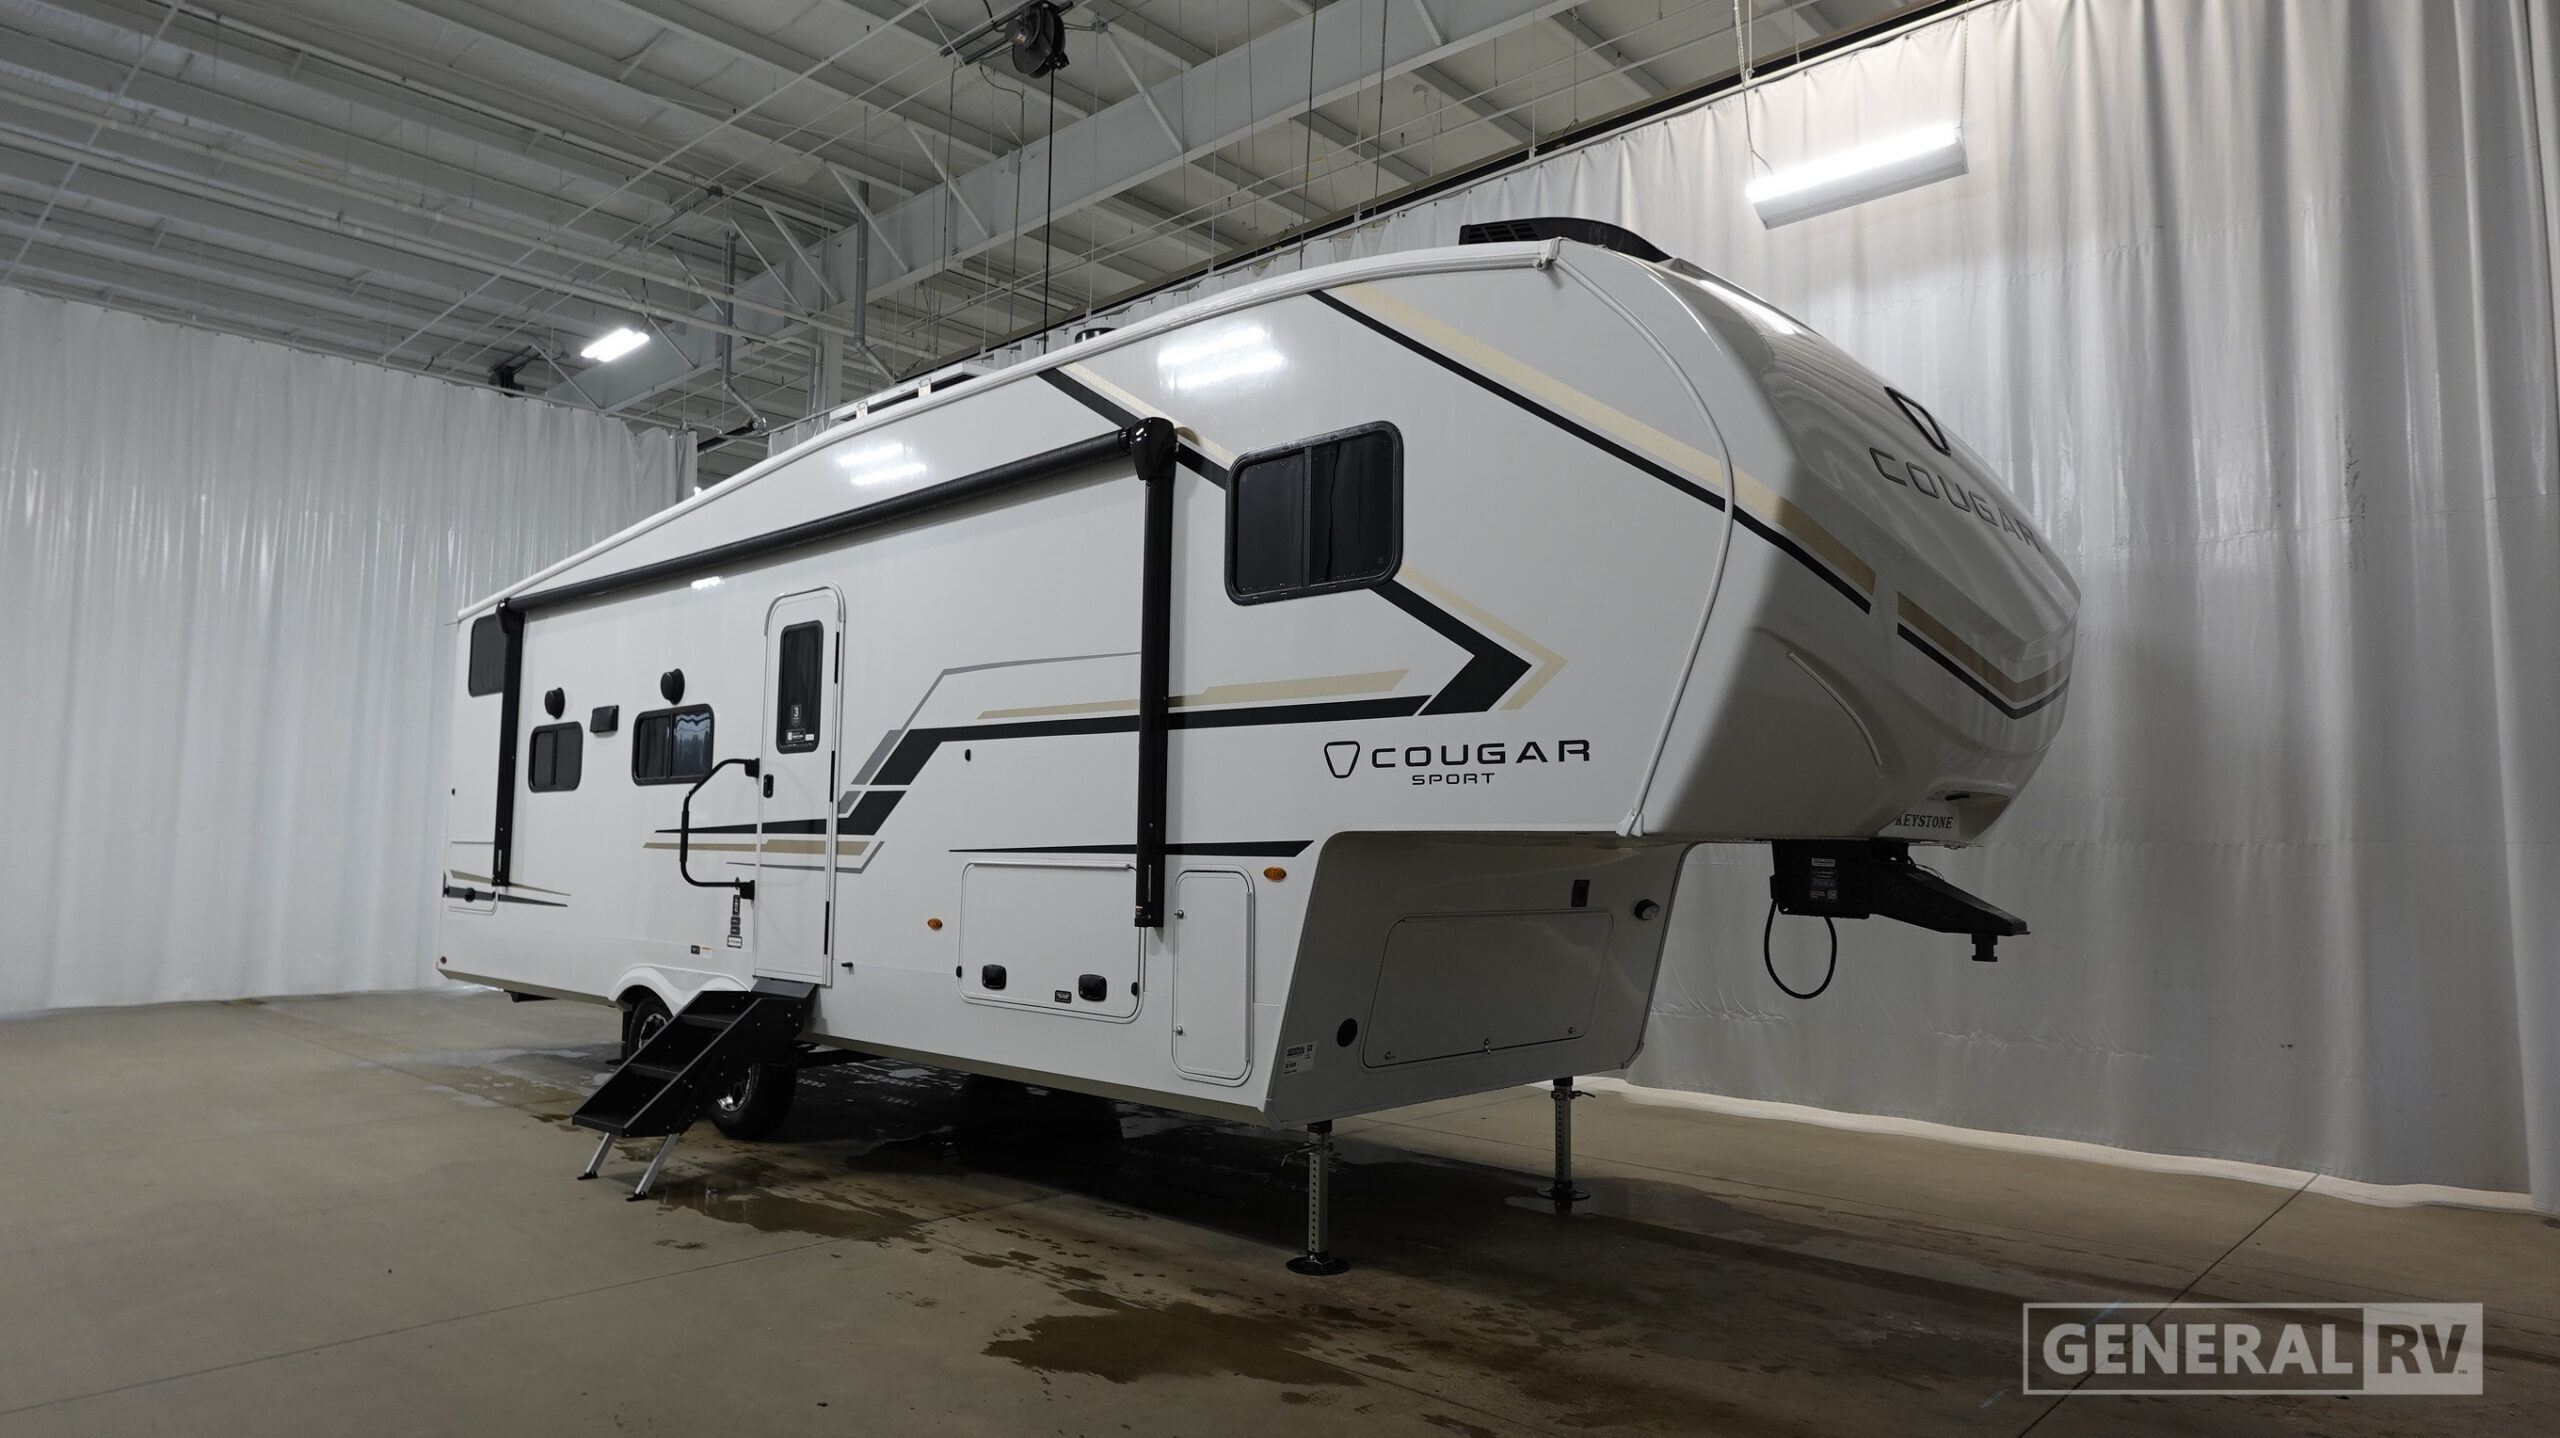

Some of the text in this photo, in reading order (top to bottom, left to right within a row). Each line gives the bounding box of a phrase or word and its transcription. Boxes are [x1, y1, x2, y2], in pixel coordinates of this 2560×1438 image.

[1869, 447, 2042, 553] COUGAR
[1371, 739, 1590, 768] COUGAR
[1412, 772, 1495, 786] SPORT
